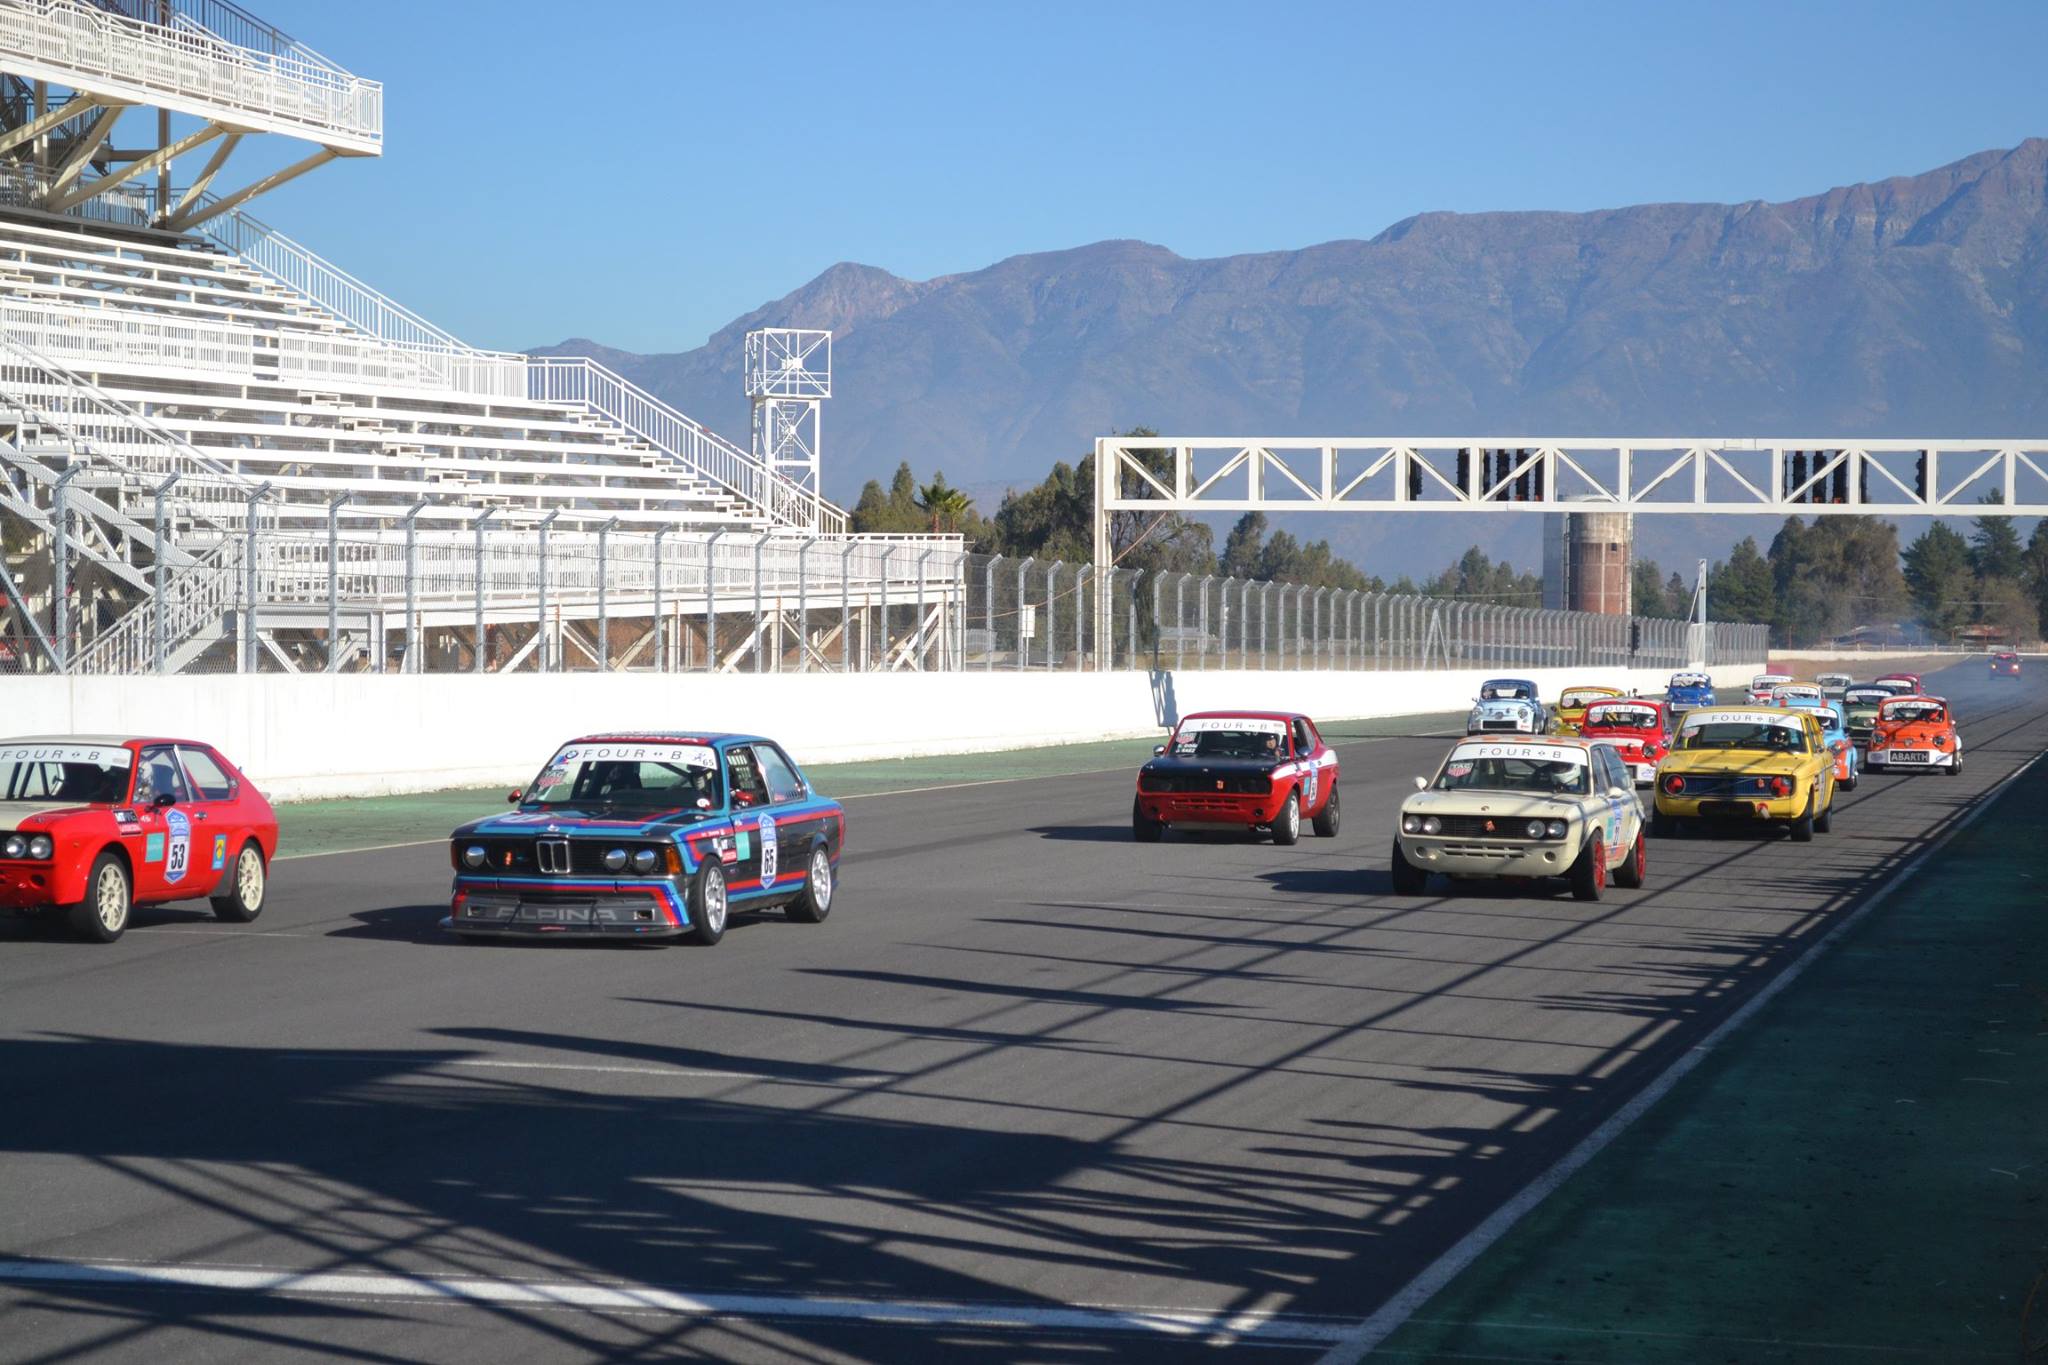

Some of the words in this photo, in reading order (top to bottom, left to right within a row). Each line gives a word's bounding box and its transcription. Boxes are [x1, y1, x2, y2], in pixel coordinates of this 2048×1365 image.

[1711, 714, 1752, 722] FOUR
[1201, 721, 1243, 729] FOUR
[0, 750, 64, 760] FOUR
[88, 751, 100, 761] B
[582, 748, 646, 758] FOUR
[670, 750, 682, 760] B
[1479, 747, 1531, 756] FOUR
[1552, 750, 1562, 759] B
[1891, 752, 1928, 761] ABARTH
[702, 758, 714, 767] 65
[170, 843, 186, 870] 53
[764, 848, 774, 875] 65
[495, 907, 617, 921] ALPINA
